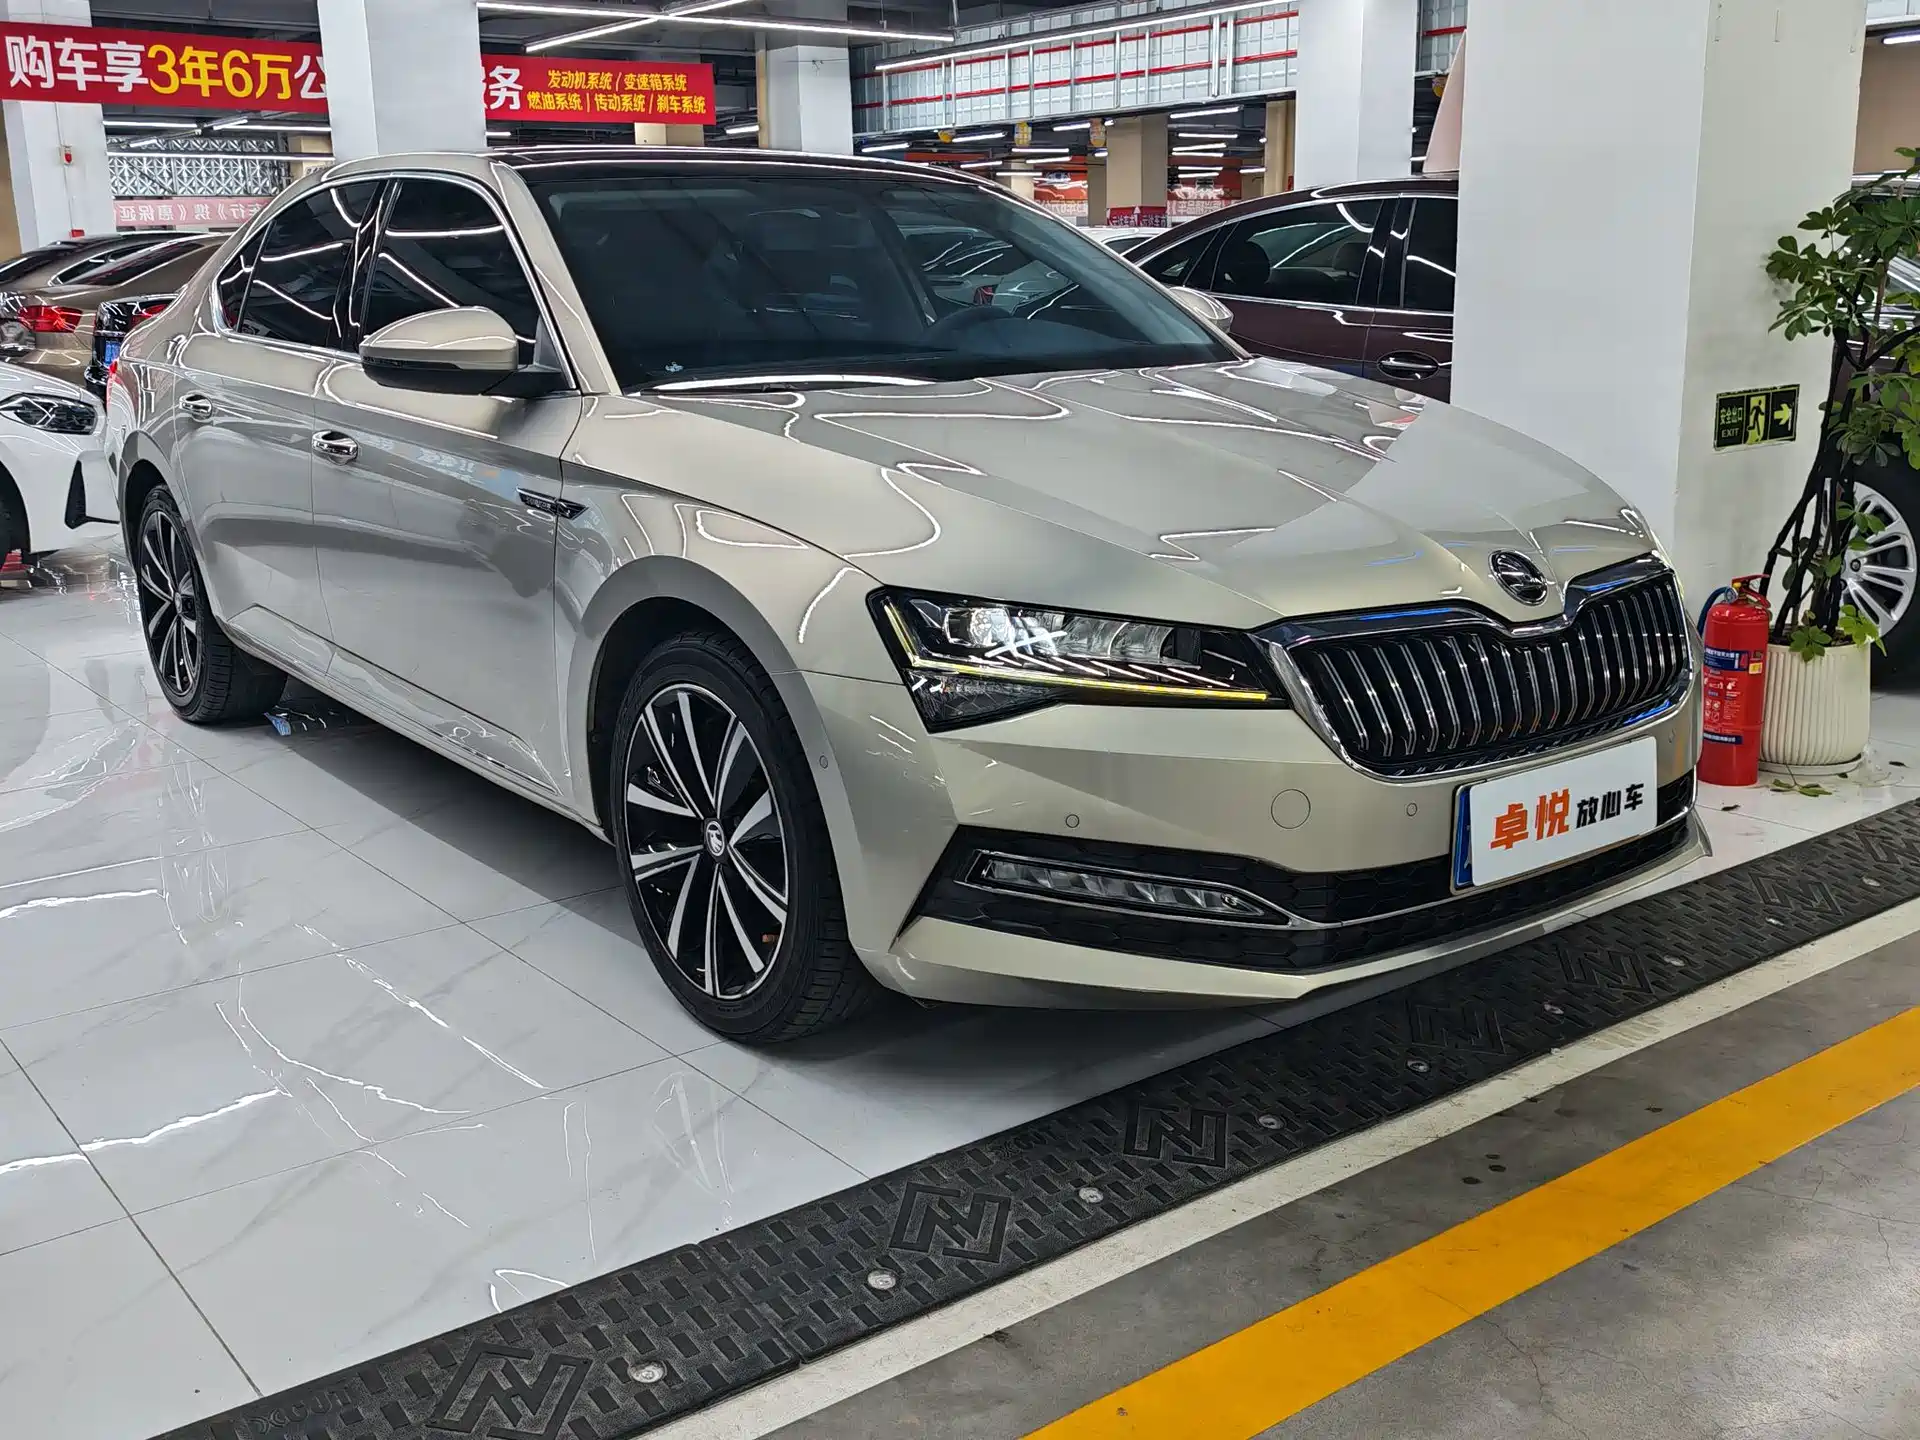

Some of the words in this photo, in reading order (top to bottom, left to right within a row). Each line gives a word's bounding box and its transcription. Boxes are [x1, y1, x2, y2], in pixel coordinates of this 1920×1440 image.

[1720, 405, 1744, 425] 安全出口
[1721, 428, 1740, 438] EXIT
[1490, 788, 1570, 850] 卓悦
[1575, 783, 1644, 829] 放心车
